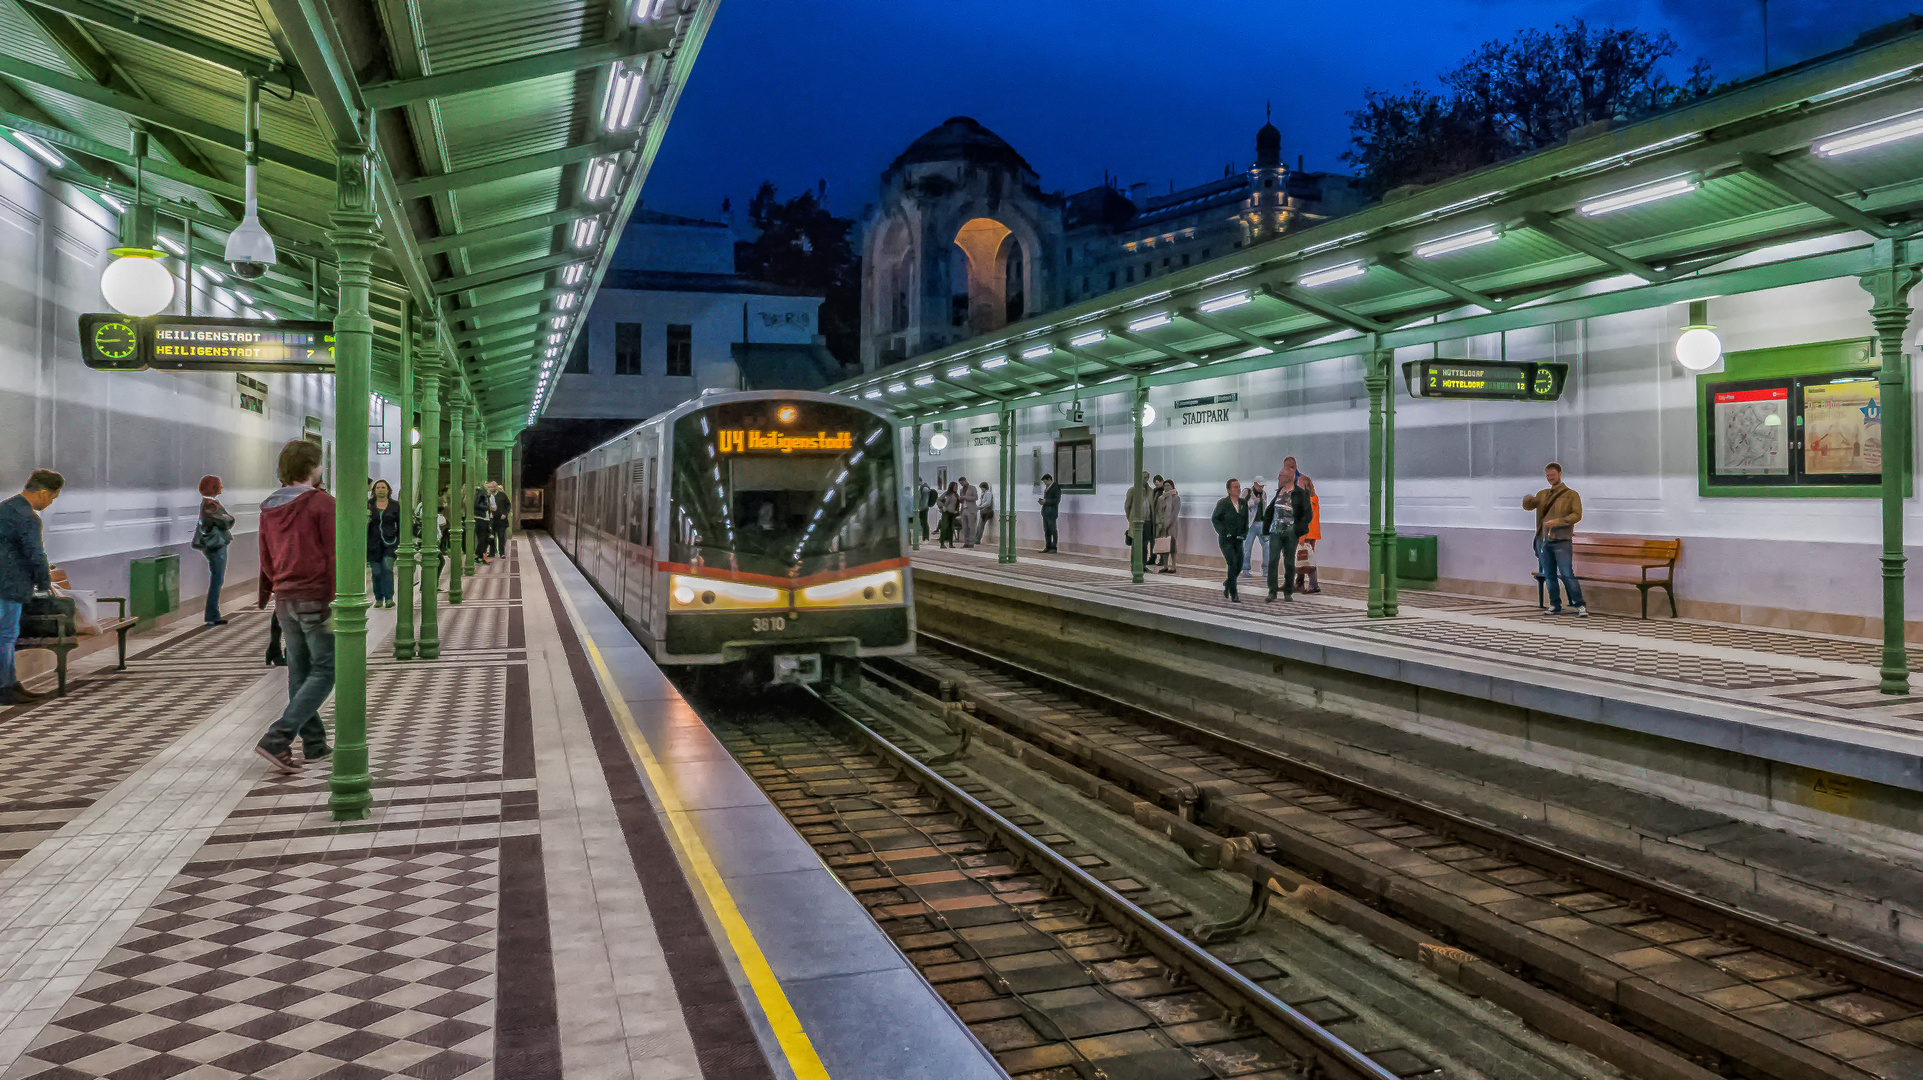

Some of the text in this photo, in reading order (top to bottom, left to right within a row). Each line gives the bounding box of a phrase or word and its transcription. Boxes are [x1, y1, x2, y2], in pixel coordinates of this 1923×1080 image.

[156, 330, 261, 343] HEILIGENSTADT
[156, 345, 315, 359] HEILIGENSTADT 7
[328, 346, 336, 359] 1
[1430, 377, 1437, 388] 2
[1516, 382, 1525, 390] 12
[1182, 408, 1230, 425] STADTPARK
[719, 430, 852, 453] U4 Heiligenstadt
[752, 616, 786, 632] 3810
